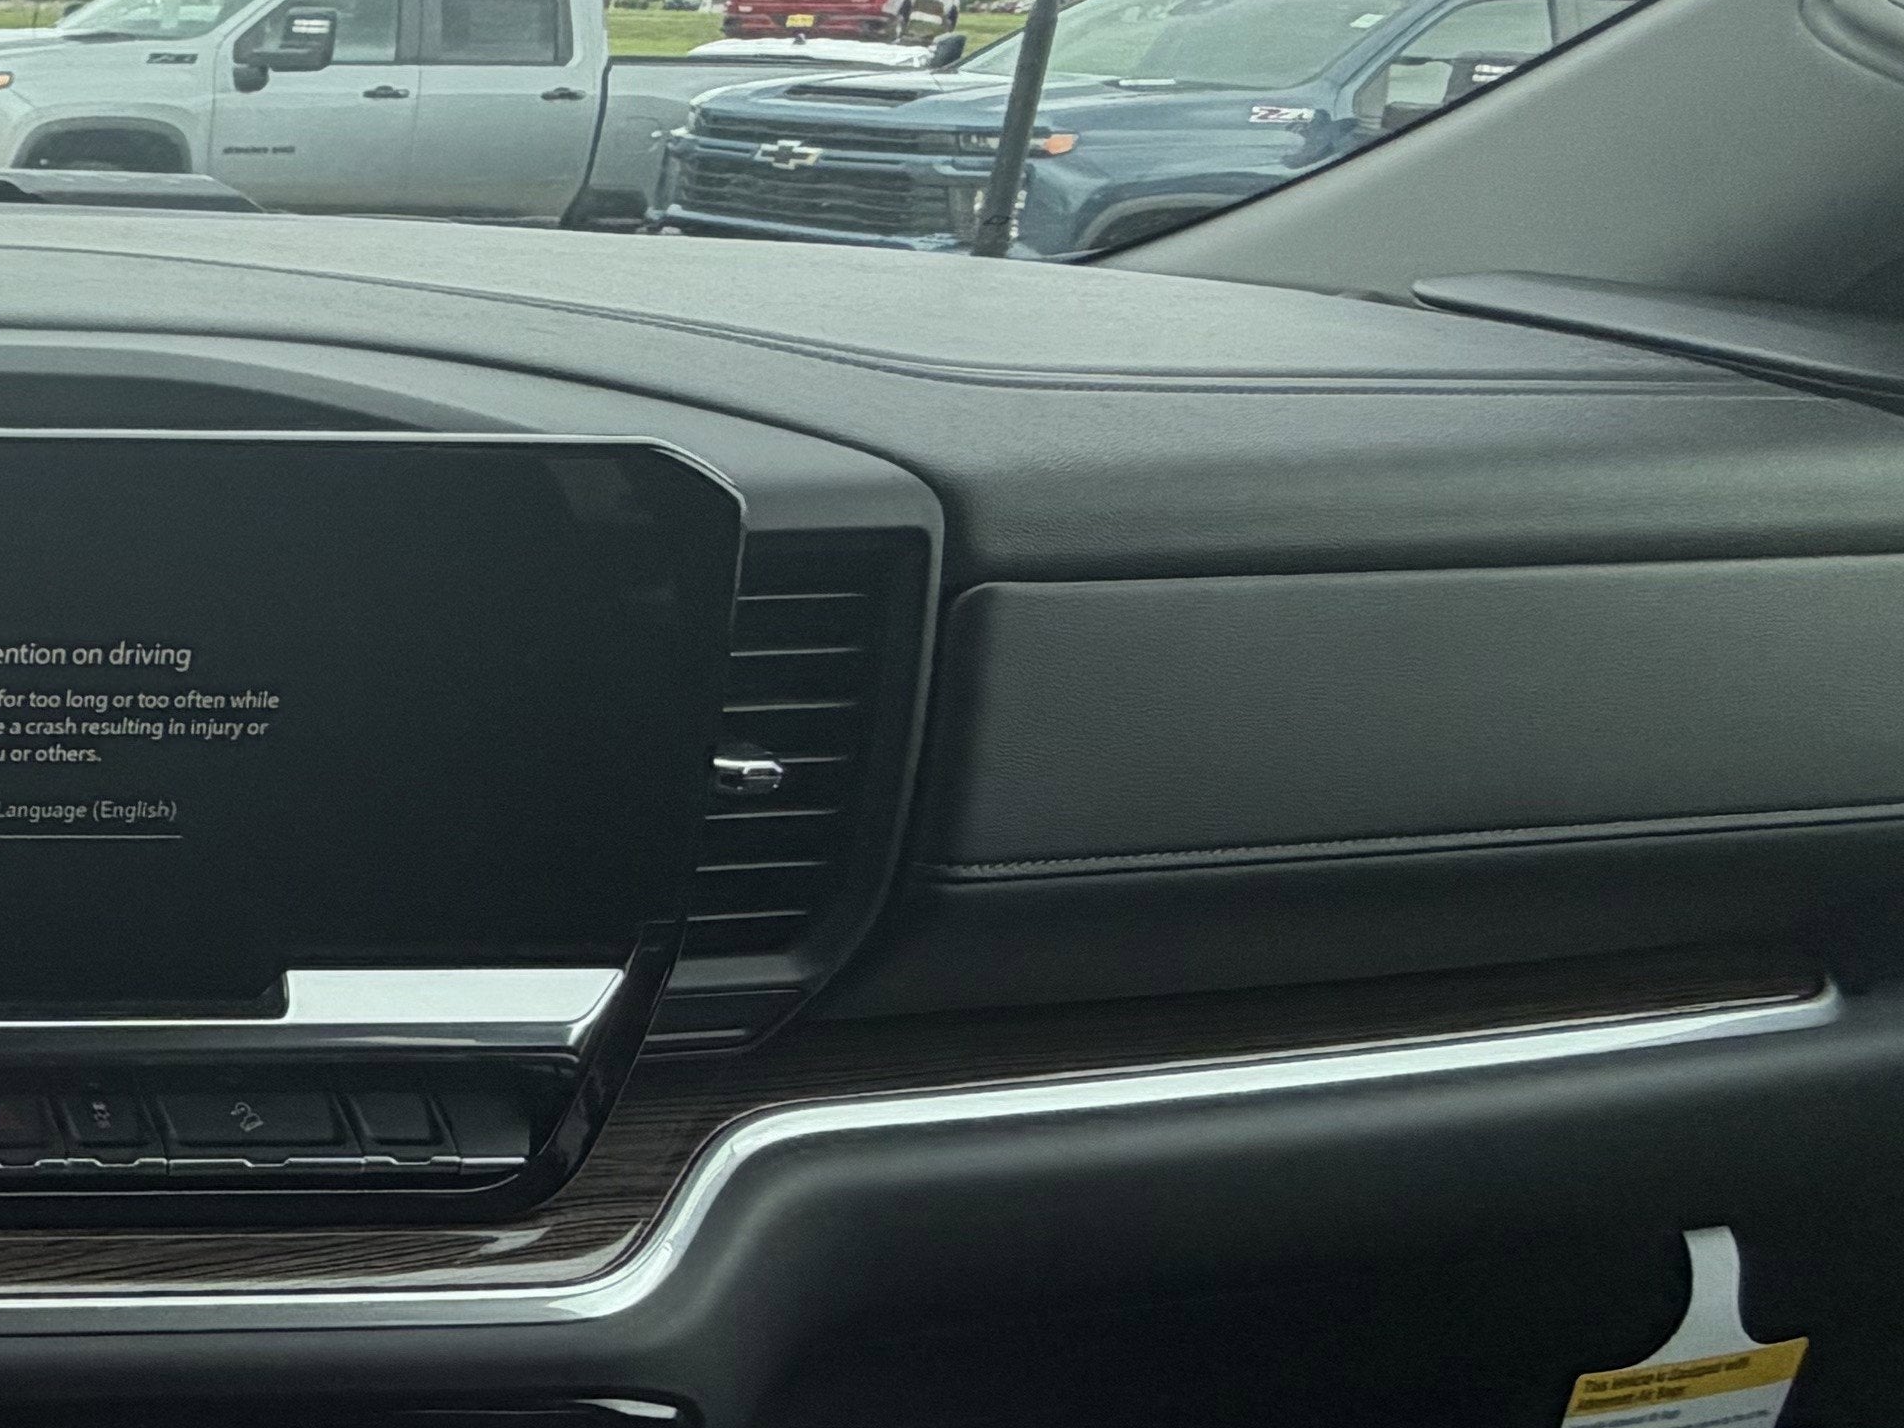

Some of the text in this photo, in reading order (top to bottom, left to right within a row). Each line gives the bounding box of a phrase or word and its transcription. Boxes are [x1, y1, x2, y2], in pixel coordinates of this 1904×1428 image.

[72, 646, 103, 665] on
[109, 641, 193, 672] driving
[29, 691, 61, 709] too
[65, 689, 109, 713] long
[112, 694, 133, 709] or
[138, 692, 170, 710] too
[174, 690, 226, 710] often
[230, 690, 281, 710] while
[9, 722, 22, 736] a
[25, 717, 77, 736] crash
[81, 717, 164, 740] resulting
[168, 718, 186, 736] in
[190, 718, 244, 741] injury
[246, 721, 270, 736] or
[9, 747, 33, 763] or
[35, 743, 103, 763] others.
[92, 799, 178, 824] (English)
